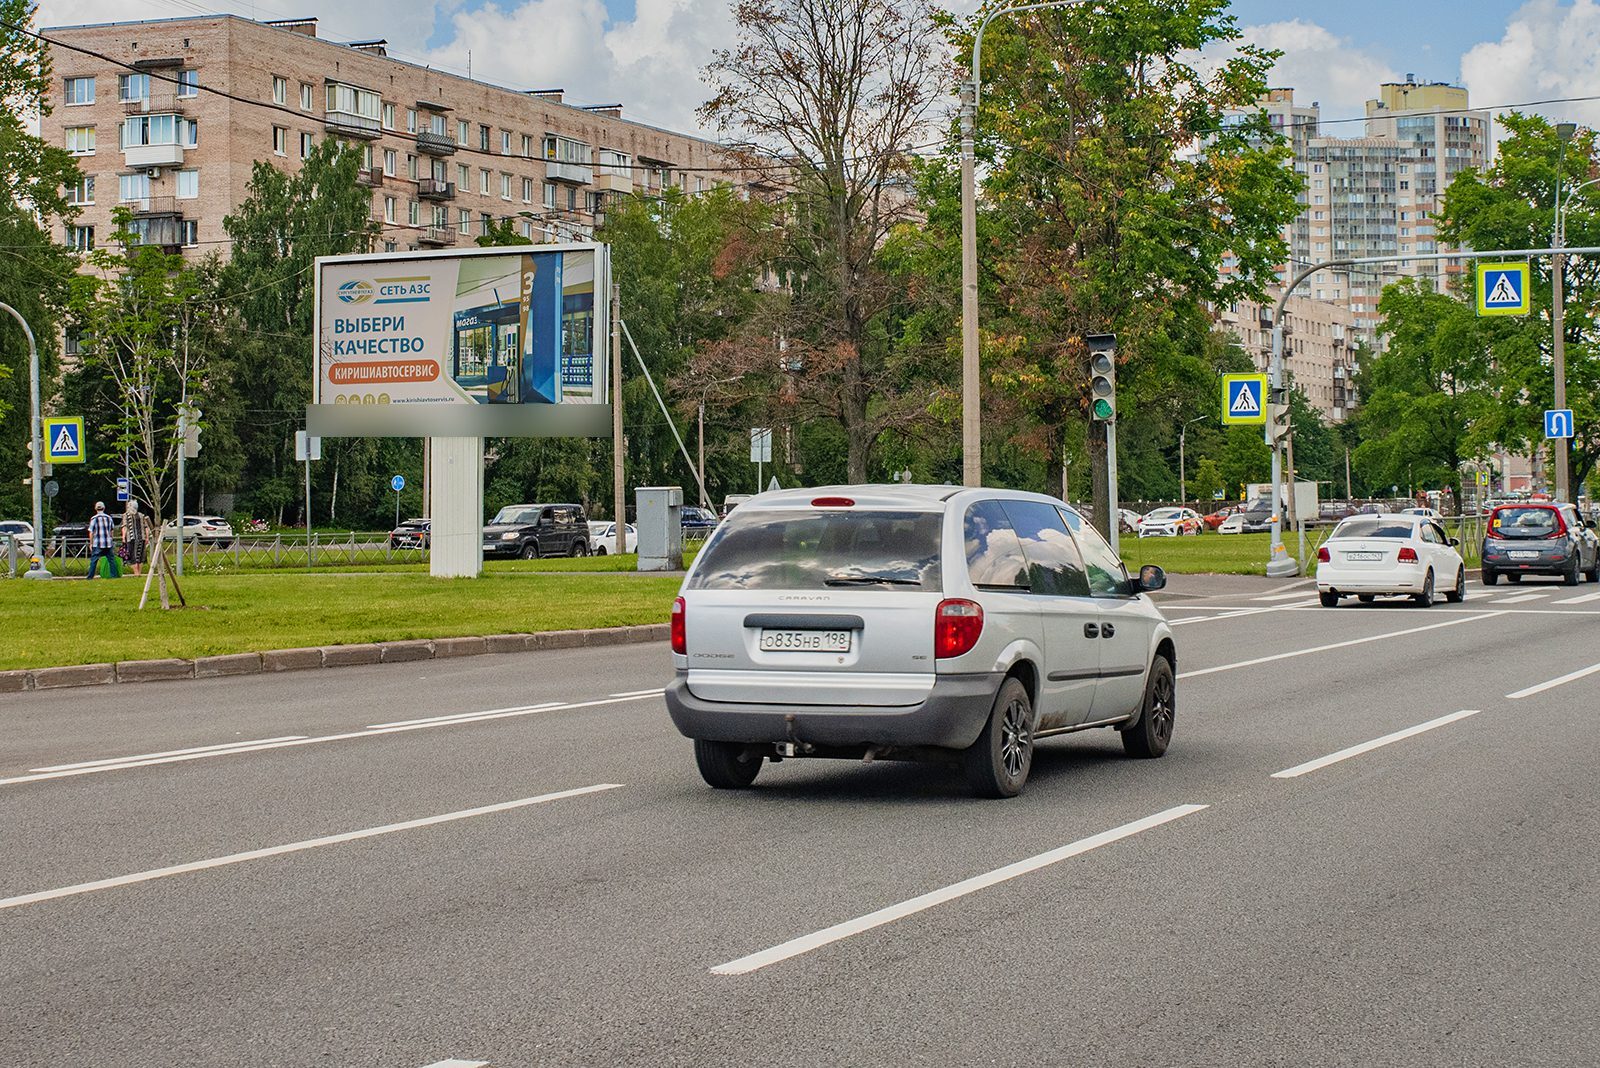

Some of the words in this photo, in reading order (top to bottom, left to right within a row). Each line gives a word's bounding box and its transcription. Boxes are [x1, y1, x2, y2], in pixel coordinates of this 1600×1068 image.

[380, 285, 407, 296] СЕТЬ
[409, 284, 431, 295] АЗС
[523, 271, 535, 295] 3
[335, 316, 405, 334] ВЫБЕРИ
[334, 337, 425, 355] КАЧЕСТВО
[335, 364, 435, 380] КИРИШИАВТОСЕРВИС
[824, 632, 846, 645] 198
